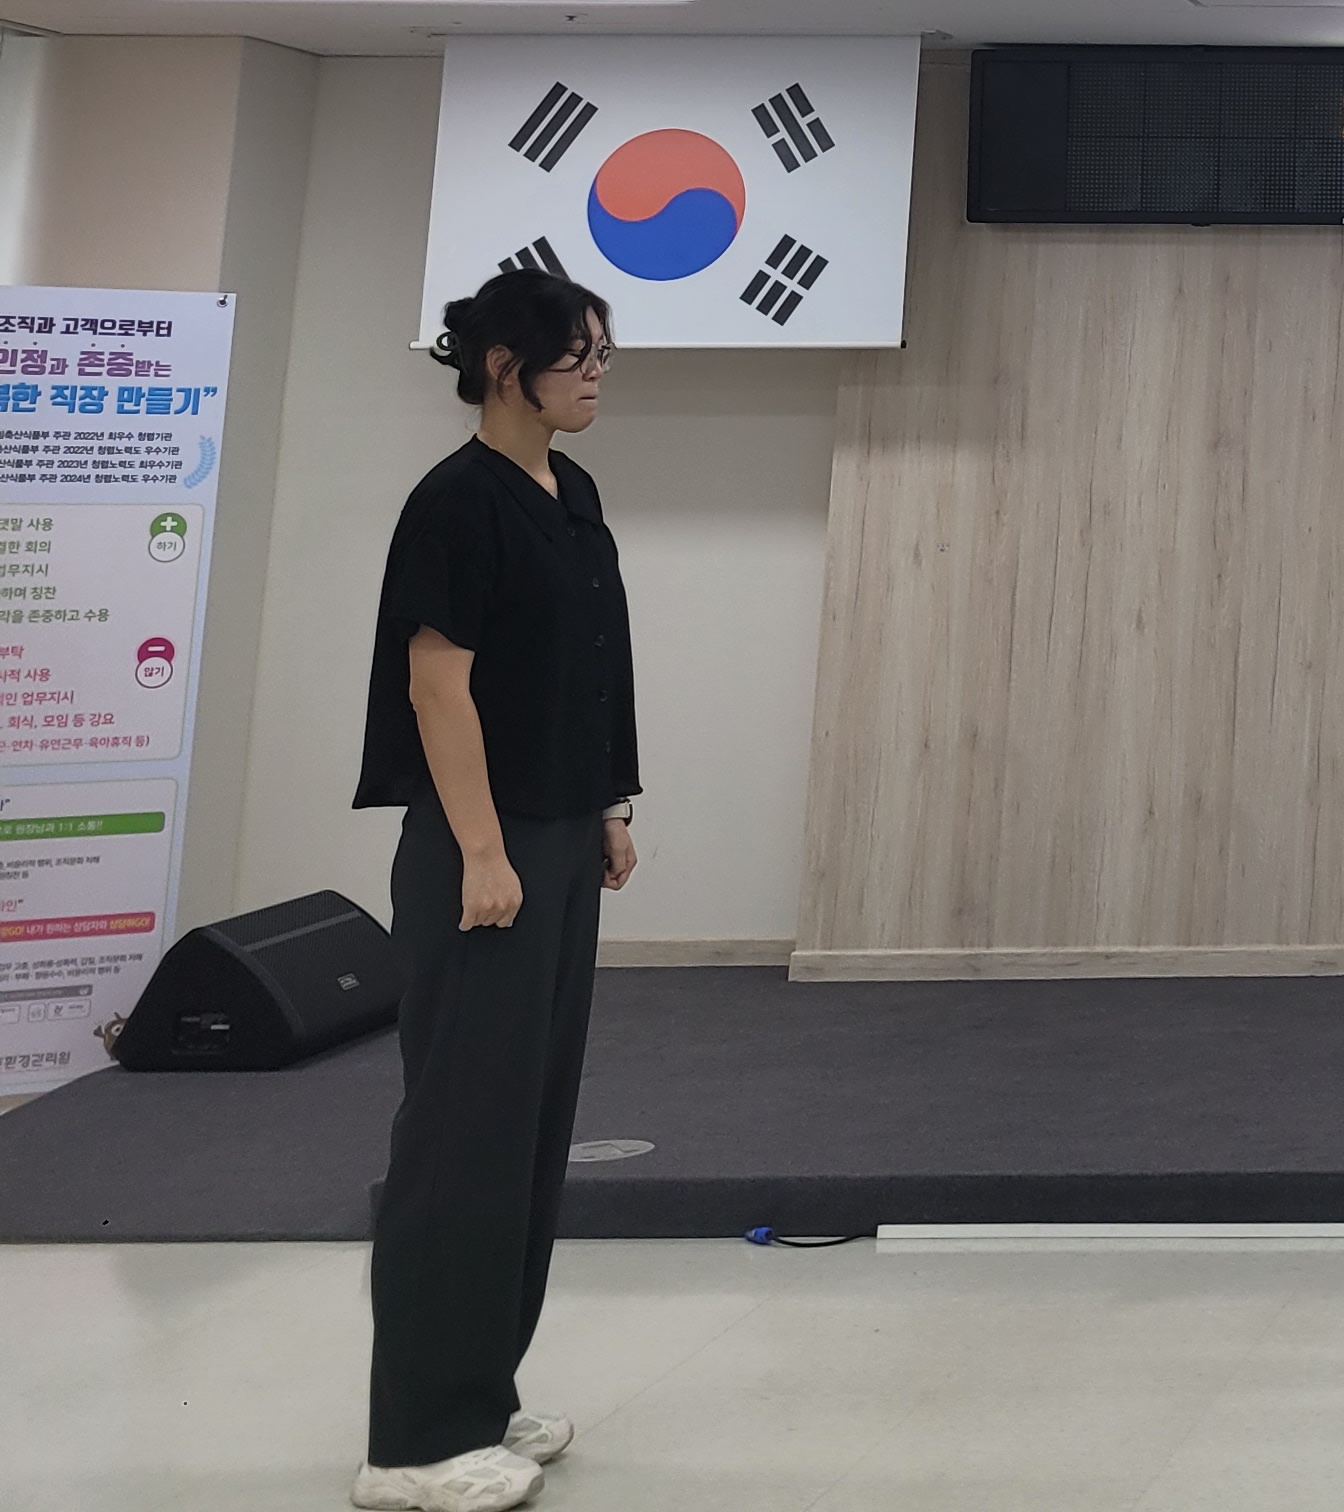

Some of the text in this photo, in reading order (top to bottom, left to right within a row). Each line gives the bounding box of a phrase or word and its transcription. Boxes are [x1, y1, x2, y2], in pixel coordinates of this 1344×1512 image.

[0, 316, 173, 337] 조직과 고객으로부터
[0, 348, 172, 378] 인정과 존중받는
[50, 384, 109, 414] 직장
[53, 430, 71, 440] 주관
[74, 431, 104, 441] 2022년
[107, 431, 135, 441] 최우수
[0, 444, 39, 454] 산식품부
[42, 445, 61, 454] 주관
[63, 445, 95, 455] 2022년
[144, 446, 181, 456] 우수기관
[36, 459, 55, 469] 주관
[57, 459, 88, 469] 2023년
[139, 460, 183, 470] 최우수기관
[39, 474, 58, 483] 주관
[60, 474, 91, 484] 2024년
[142, 474, 177, 484] 우수기관
[27, 518, 54, 531] 사용
[24, 541, 51, 554] 회의
[156, 541, 177, 551] 하기
[30, 586, 57, 600] 칭찬
[28, 609, 80, 623] 존중하고
[84, 608, 110, 622] 수용
[24, 668, 51, 682] 사용
[144, 666, 165, 678] 않기
[22, 690, 74, 706] 업무지시
[42, 714, 69, 728] 모임
[72, 714, 85, 727] 등
[89, 713, 115, 727] 강요
